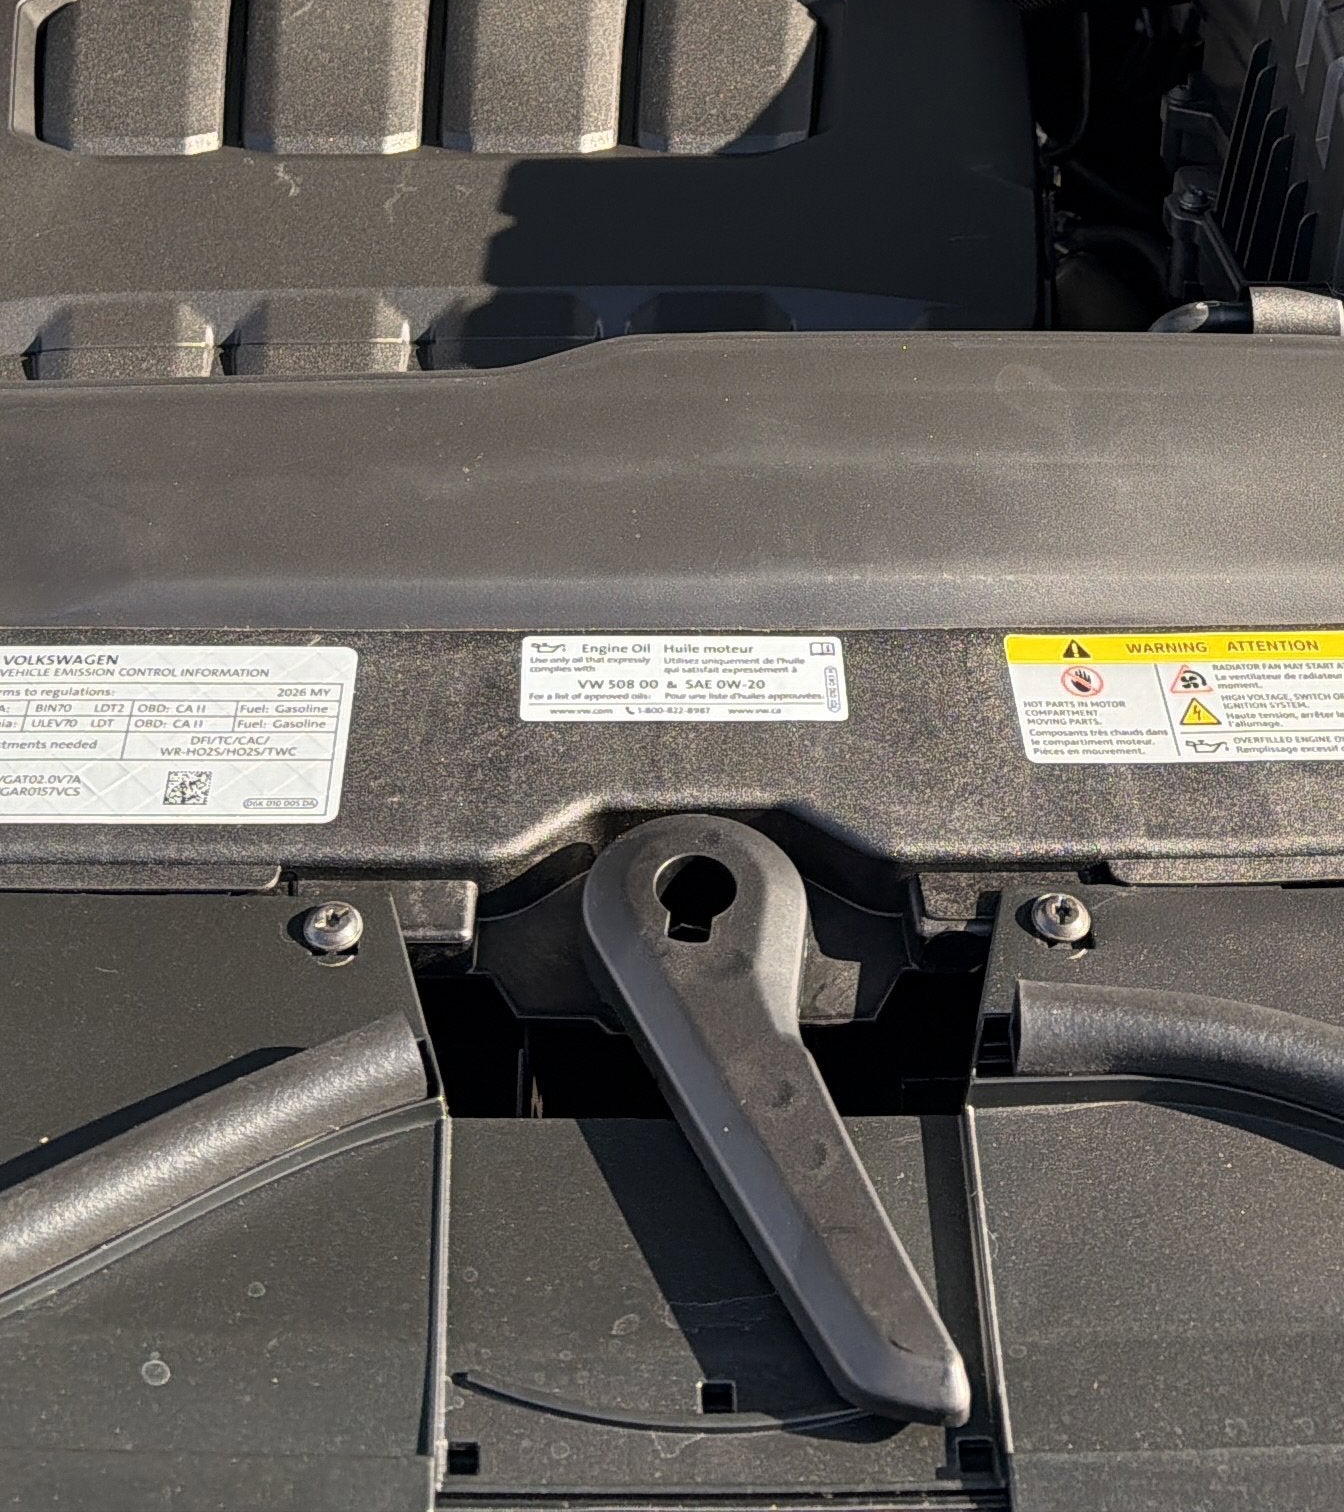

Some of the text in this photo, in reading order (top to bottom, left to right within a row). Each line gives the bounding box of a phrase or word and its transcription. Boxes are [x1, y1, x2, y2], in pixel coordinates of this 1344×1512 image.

[582, 643, 651, 655] Engine Oil
[664, 644, 754, 654] Huile moteur
[1126, 640, 1320, 654] WARNING ATTENTION
[3, 655, 119, 665] VOLKSWAGEN
[550, 657, 570, 665] only
[607, 657, 651, 665] expressly
[701, 658, 760, 666] uniquement
[0, 668, 270, 678] VEHICLE EMISSION CONTROL INFORMATION
[530, 666, 572, 674] complies
[722, 666, 789, 675] expressément
[578, 679, 766, 690] VW 508 00 & SAE 0W-20
[24, 688, 38, 697] to
[41, 688, 115, 698] regulations:
[277, 688, 331, 697] 2026 MY
[584, 693, 629, 701] approved
[35, 704, 125, 712] BIN70 LDT2
[137, 704, 170, 713] OBD:
[176, 705, 193, 713] CA
[239, 704, 329, 713] Fuel: Gasoline
[1226, 712, 1256, 720] Haute
[1258, 712, 1298, 720] tension,
[31, 719, 115, 728] ULEV70 LDT
[134, 719, 167, 728] OBD:
[173, 720, 191, 728] CA
[237, 719, 326, 729] Fuel: Gasoline
[1029, 729, 1088, 737] Composants
[190, 736, 271, 745] DFI/TC/CAC/
[1233, 736, 1292, 744] OVERFILLED
[50, 740, 98, 750] needed
[161, 747, 297, 756] WR-HO2S/HO2S/TWC
[1236, 746, 1298, 754] Remplissage
